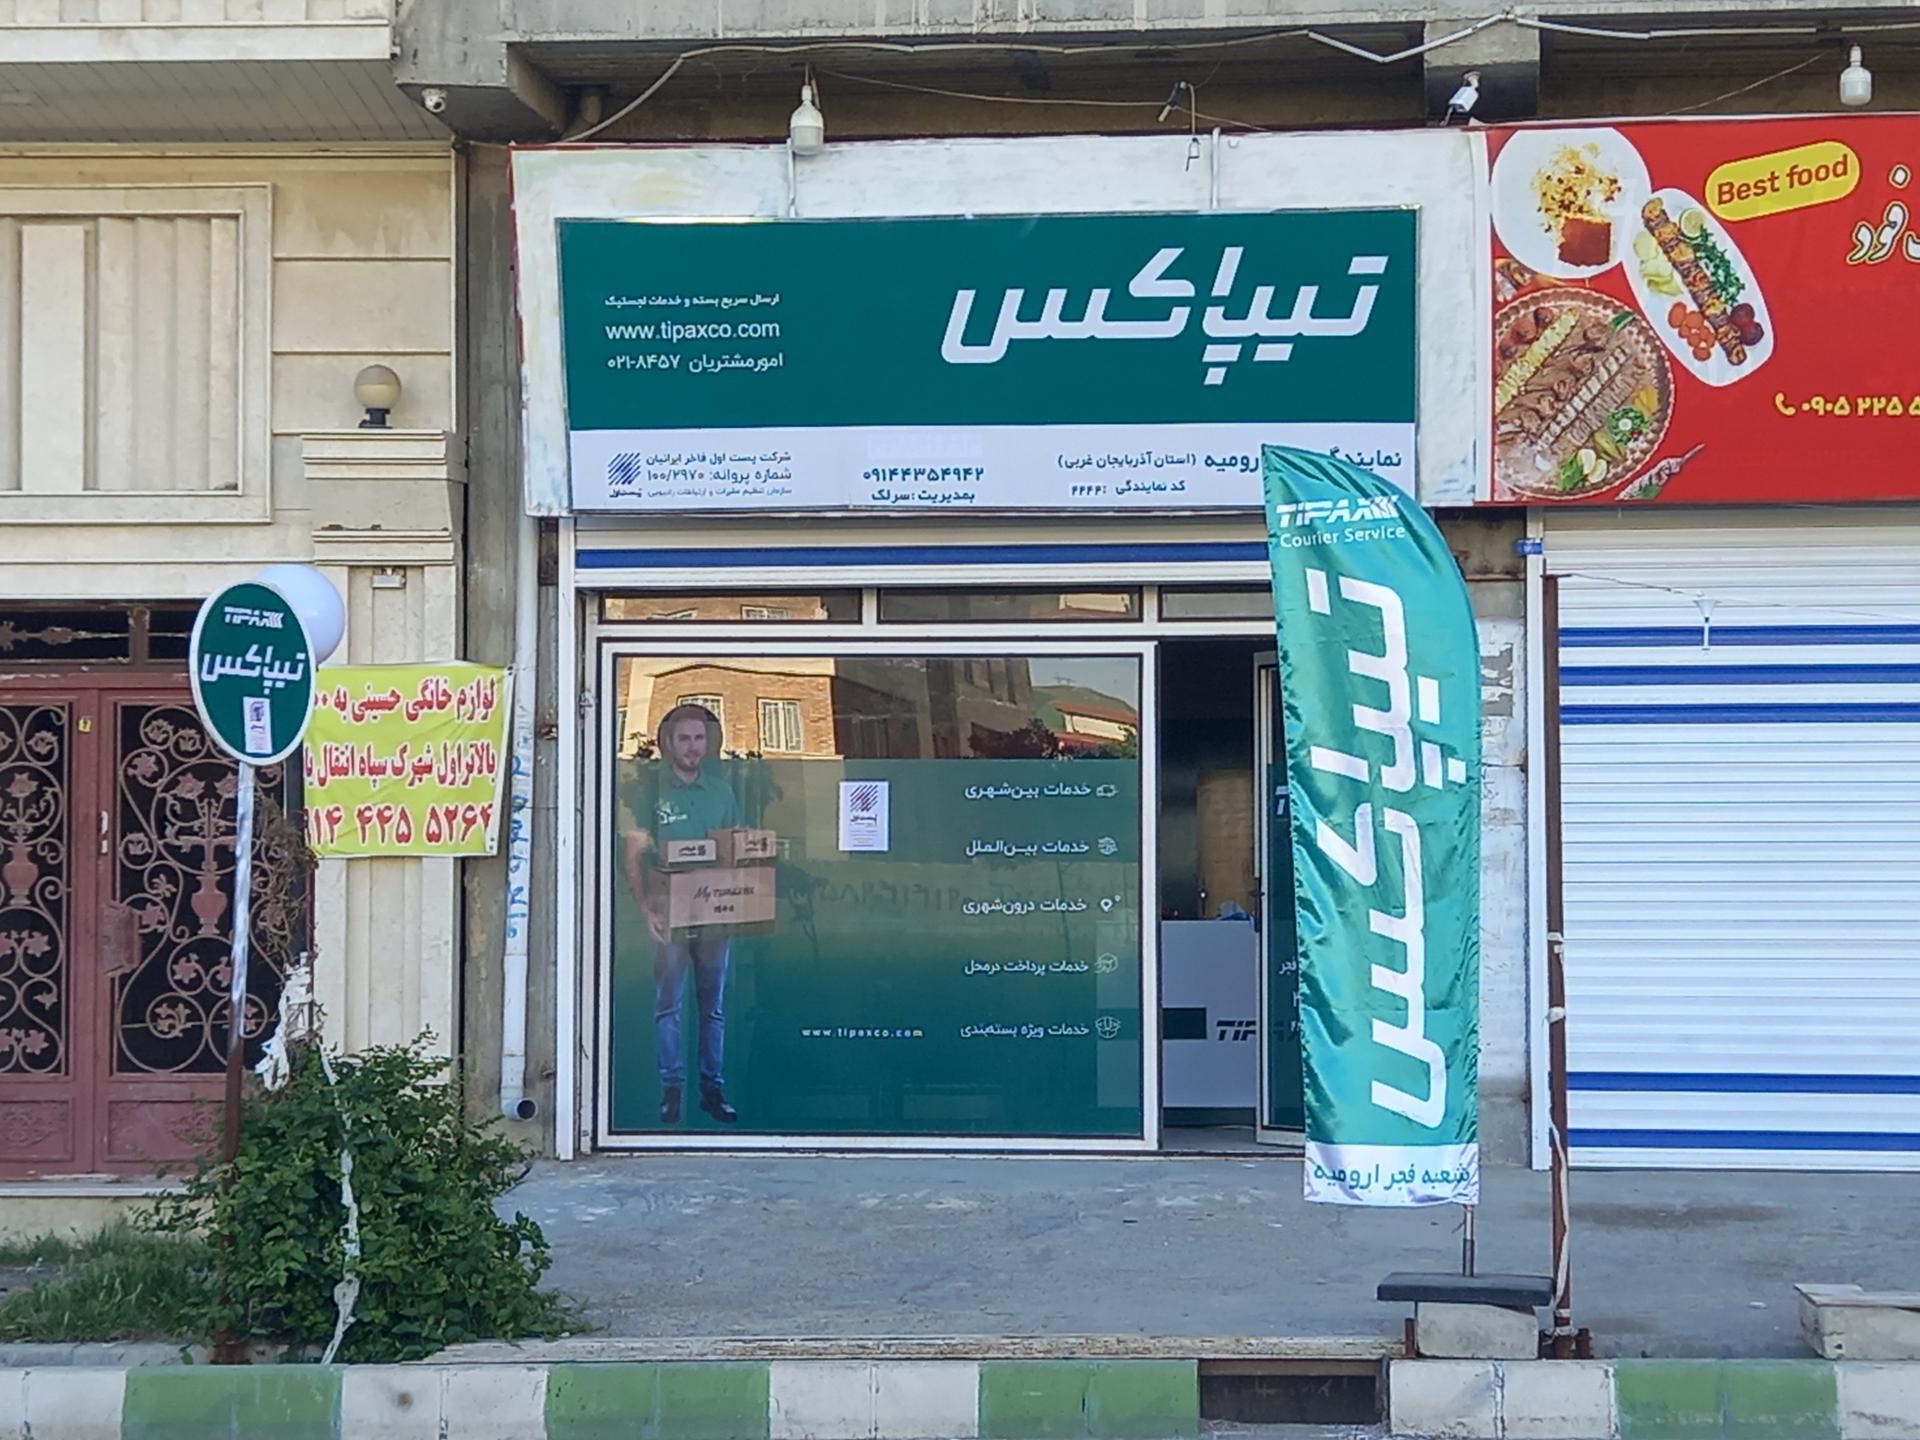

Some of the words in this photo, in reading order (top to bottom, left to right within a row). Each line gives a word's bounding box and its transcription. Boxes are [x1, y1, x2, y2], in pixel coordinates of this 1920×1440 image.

[1716, 171, 1780, 206] Best
[1786, 153, 1849, 189] food
[605, 296, 647, 309] لجستیک
[648, 295, 682, 306] خدمات
[683, 298, 690, 307] و
[692, 296, 719, 307] بسته
[720, 297, 748, 309] سریع
[750, 293, 779, 306] ارسال
[940, 246, 1389, 386] تیپاکس
[605, 320, 781, 343] www.tipaxco.com
[607, 354, 681, 369] ۰۲۱-۸۴۵۷
[1801, 396, 1851, 416] ۰۹۰۵
[1856, 396, 1903, 416] ۲۲۵
[646, 454, 682, 465] ایرانیان
[684, 453, 706, 465] فاخر
[709, 453, 726, 465] اول
[728, 453, 757, 465] پست
[759, 452, 791, 465] شرکت
[1096, 451, 1152, 469] آذربایجان
[1204, 453, 1259, 473] رومیه
[648, 469, 704, 482] ۱۰۰/۲۹۷۰
[709, 469, 750, 484] پروانه:
[754, 468, 791, 483] شماره
[863, 467, 984, 482] ۰۹۱۴۴۳۵۴۹۴۲
[1115, 480, 1168, 495] نمایندگی
[1170, 480, 1186, 491] کد
[1280, 530, 1339, 548] Courier
[1345, 526, 1405, 543] Service
[201, 644, 306, 695] تیپاکس
[334, 687, 348, 721] به
[351, 684, 401, 722] حسینی
[405, 677, 452, 722] خانگی
[457, 677, 496, 721] لوازم
[317, 744, 355, 787] انتقال
[358, 744, 388, 789] سپاه
[1044, 783, 1091, 797] خدمات
[357, 806, 412, 844] ۴۴۵
[1042, 840, 1090, 853] خدمات
[1305, 566, 1467, 1130] تیپاکس
[1040, 898, 1087, 912] خدمات
[1003, 961, 1045, 976] پرداخت
[1049, 960, 1089, 973] خدمات
[1021, 1023, 1045, 1038] ویژه
[1048, 1023, 1090, 1036] خدمات
[1314, 1163, 1380, 1190] ارومیه
[1384, 1163, 1416, 1191] فجر
[1422, 1163, 1470, 1189] شعبه
